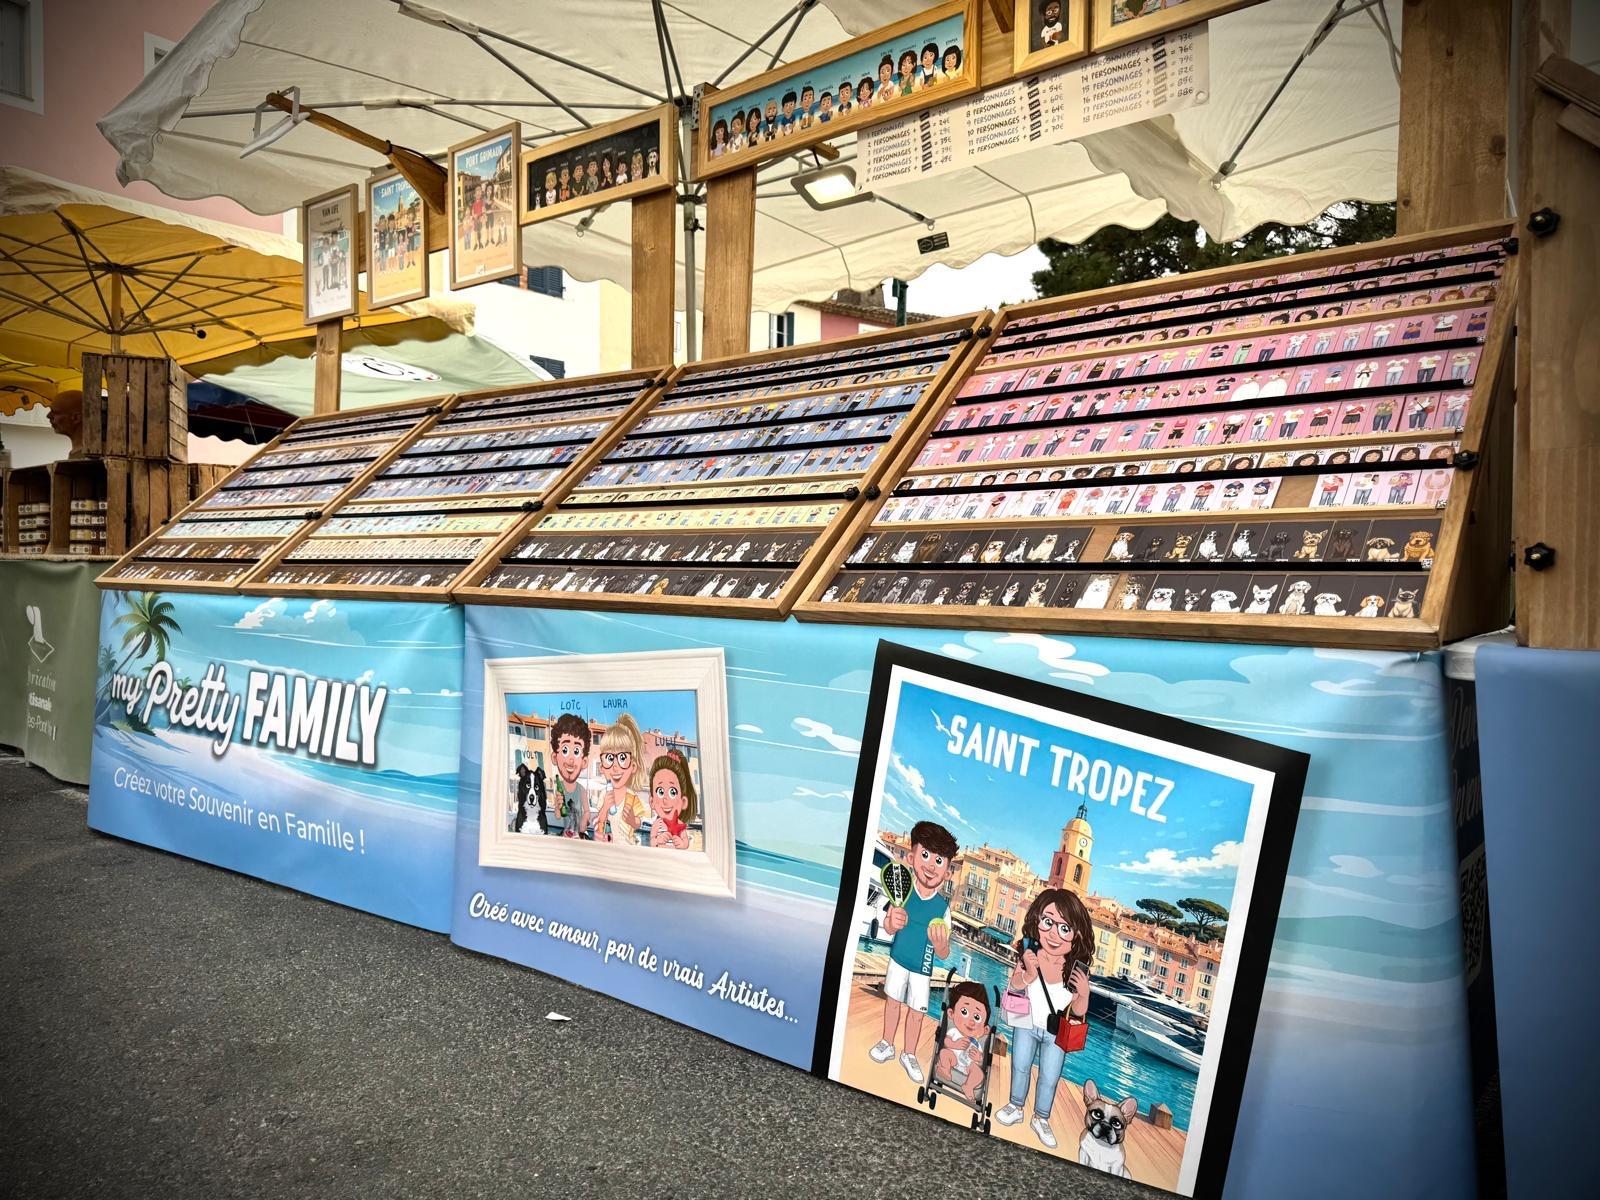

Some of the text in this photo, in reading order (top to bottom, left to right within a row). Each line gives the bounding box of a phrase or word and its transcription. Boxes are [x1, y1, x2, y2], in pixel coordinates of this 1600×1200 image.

[1091, 58, 1141, 80] PERSONNAGES
[1093, 69, 1142, 90] PERSONNAGES
[973, 88, 1014, 106] PERSONNAGES
[1093, 81, 1142, 100] PERSONNAGES
[973, 97, 1015, 115] PERSONNAGES
[1093, 91, 1141, 111] PERSONNAGES
[974, 107, 1016, 125] PERSONNAGES
[1093, 101, 1142, 120] PERSONNAGES
[977, 116, 1019, 134] PERSONNAGES
[874, 129, 910, 146] PERSONNAGES
[976, 127, 1019, 144] PERSONNAGES
[977, 136, 1019, 152] PERSONNAGES
[873, 139, 910, 155] PERSONNAGES
[873, 148, 911, 164] PERSONNAGES
[872, 167, 910, 181] PERSONNAGES
[873, 157, 911, 173] PERSONNAGES
[112, 660, 386, 764] my Pretty FAMILY
[561, 699, 628, 711] LOÏC LAURA
[947, 714, 1175, 823] SAINT TROPEZ
[114, 767, 151, 795] Créez
[153, 780, 185, 806] votre
[190, 786, 254, 825] Souvenir
[258, 811, 280, 833] en
[286, 813, 354, 851] Famille
[469, 892, 508, 922] Créé
[511, 910, 544, 933] avec
[548, 919, 601, 954] amour,
[604, 939, 634, 963] par
[638, 946, 657, 972] de
[663, 960, 704, 989] vrais
